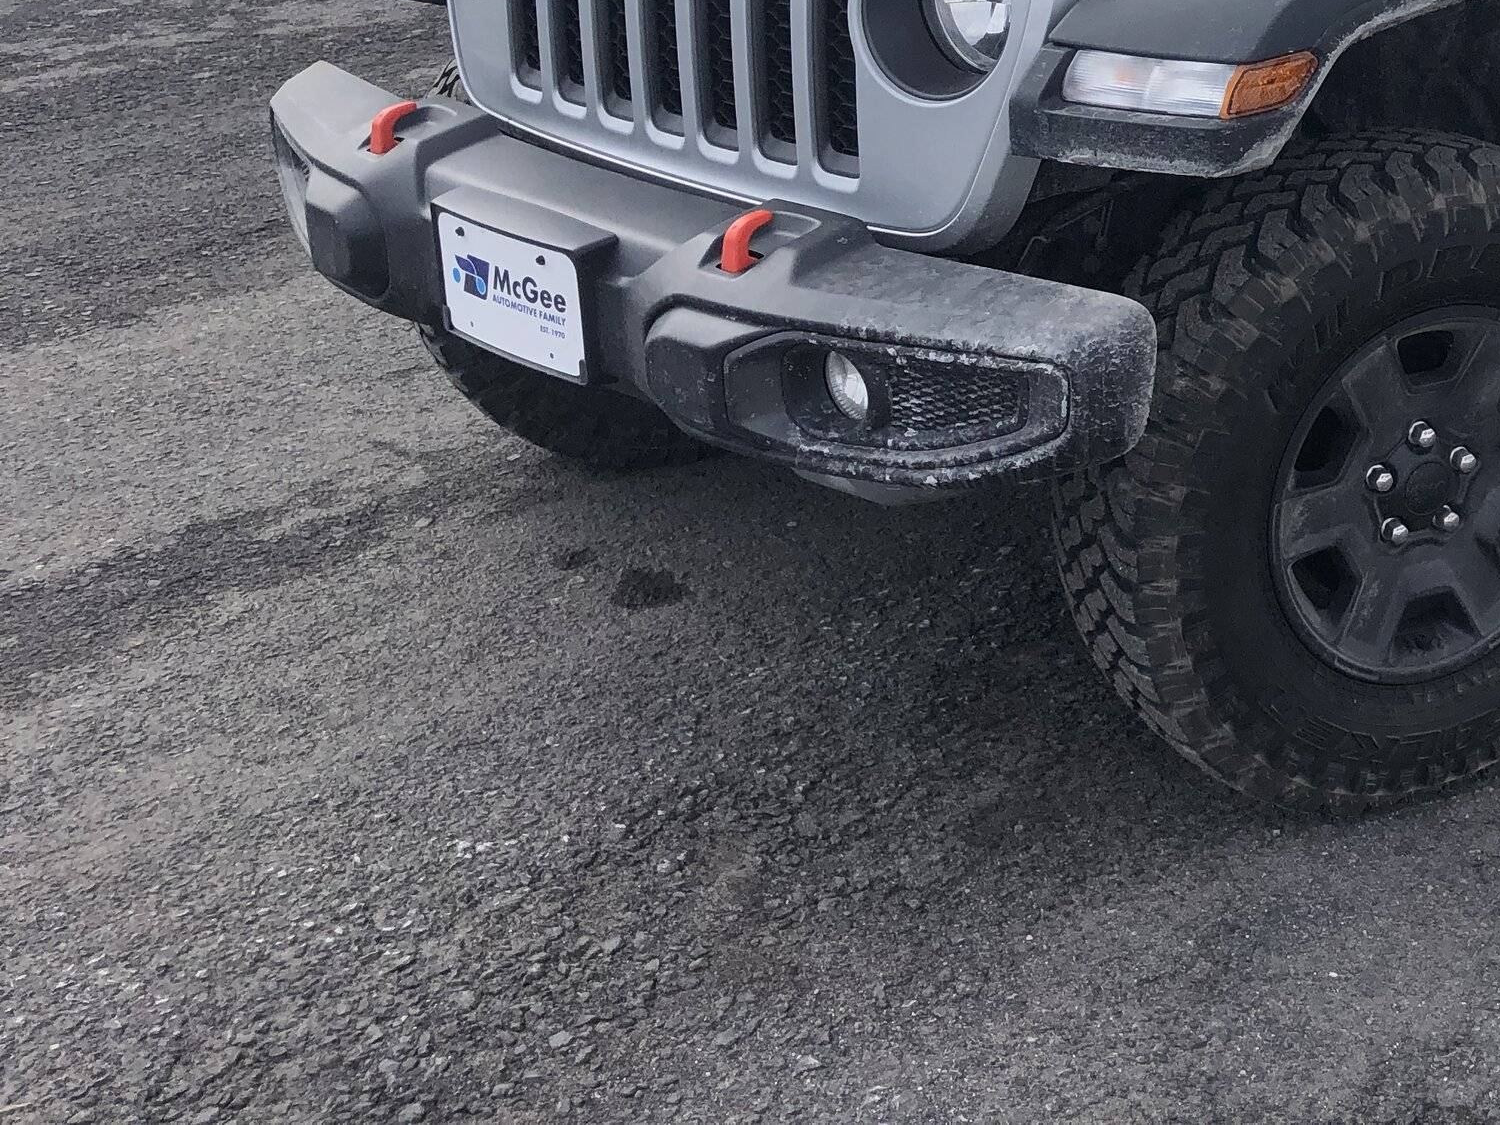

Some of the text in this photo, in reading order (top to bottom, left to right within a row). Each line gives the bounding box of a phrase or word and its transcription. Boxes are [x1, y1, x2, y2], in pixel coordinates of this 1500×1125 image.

[493, 265, 567, 313] McGee
[492, 294, 566, 327] AUTOMOTIVE FAMILY
